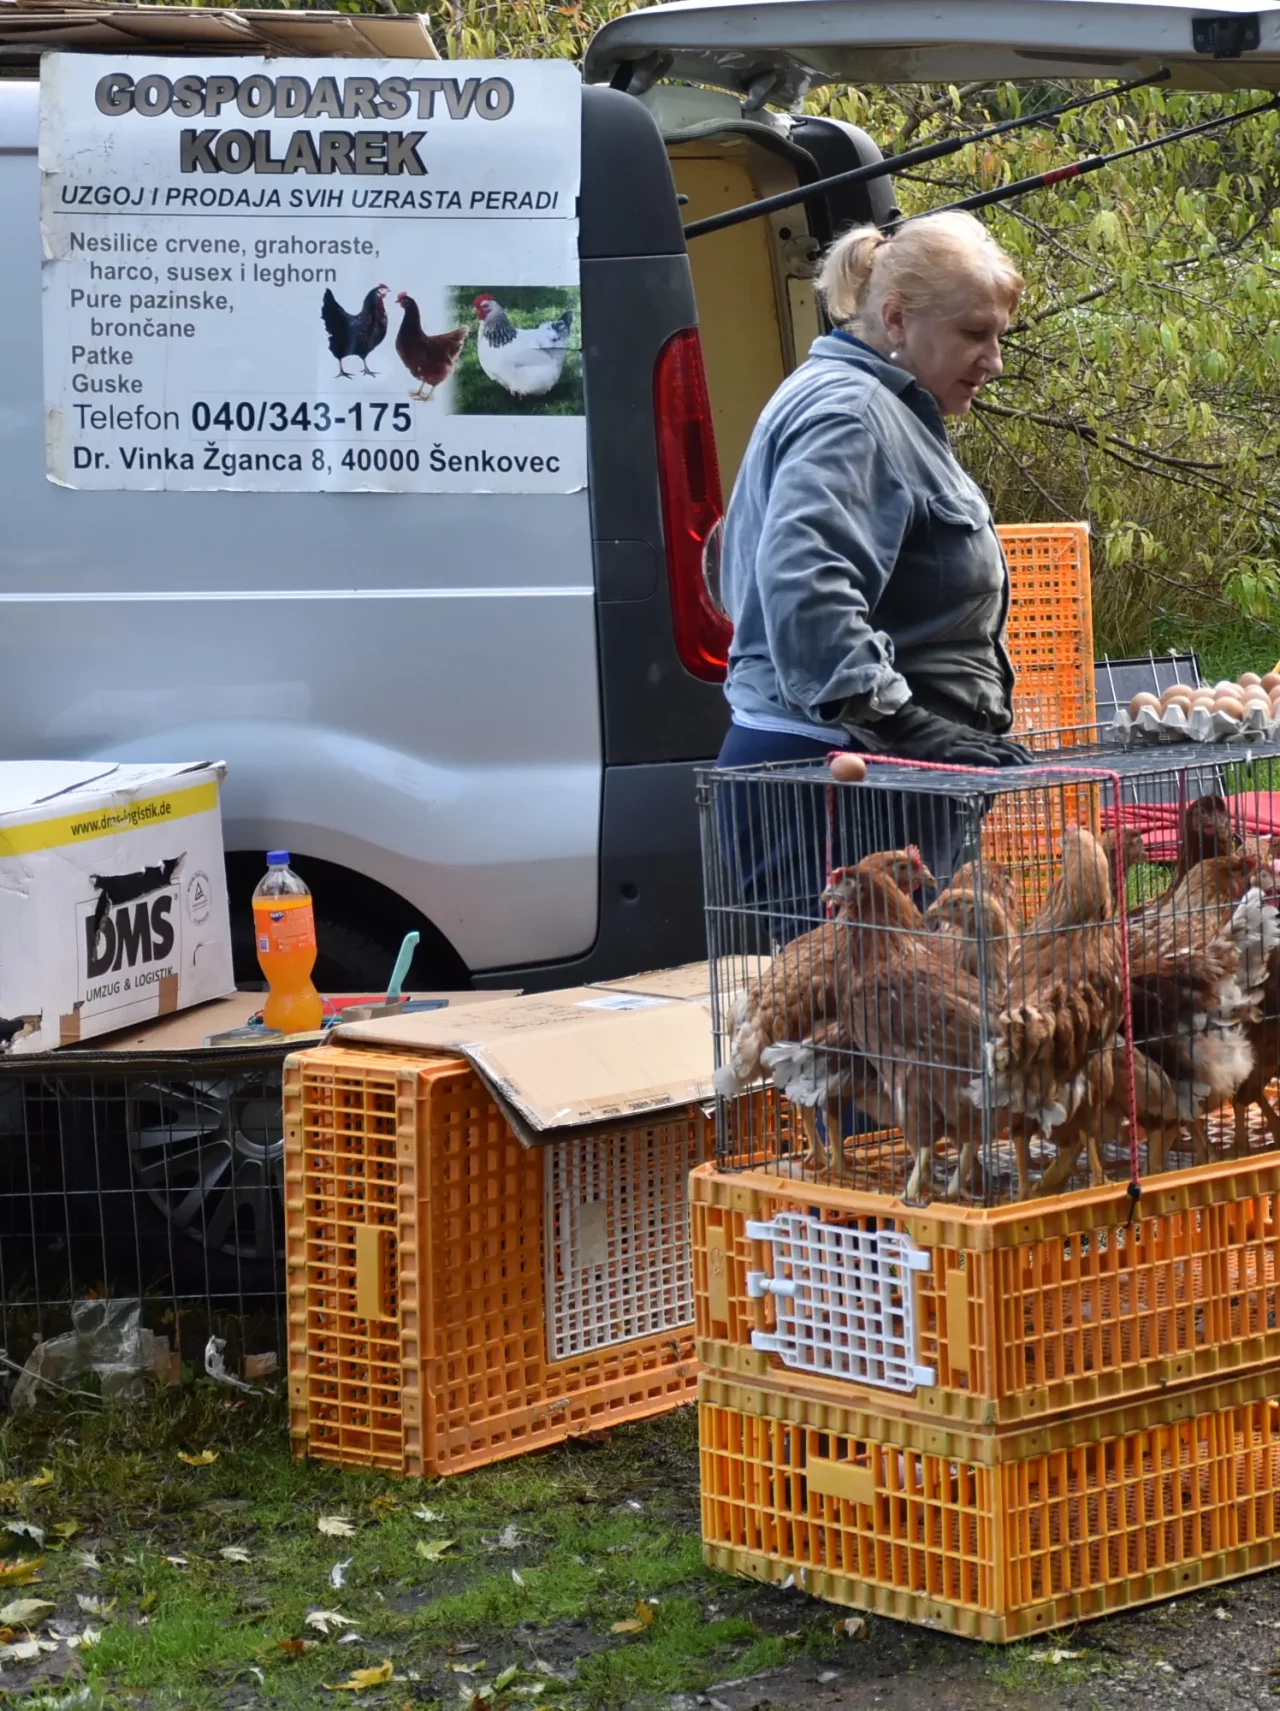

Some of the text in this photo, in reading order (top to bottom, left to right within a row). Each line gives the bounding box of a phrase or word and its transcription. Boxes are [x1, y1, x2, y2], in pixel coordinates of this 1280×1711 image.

[94, 72, 515, 120] GOSPODARSTVO
[180, 128, 429, 175] KOLAREK
[61, 185, 559, 210] UZGOJ I PRODAJA SVIH UZRASTA PERADI
[70, 232, 380, 259] Nesilice crvene, grahoraste,
[90, 261, 337, 287] harco, susex i leghorn
[70, 289, 234, 313] Pure pazinske,
[90, 317, 196, 337] brončane
[71, 345, 134, 365] Patke
[72, 373, 143, 393] Guske
[73, 401, 412, 432] Telefon 040/343-175
[73, 441, 561, 477] Dr. Vinka Žganca 8, 40000 Šenkovec
[85, 895, 175, 979] DMS
[86, 966, 173, 1002] UMZUG & LOGISTIK
